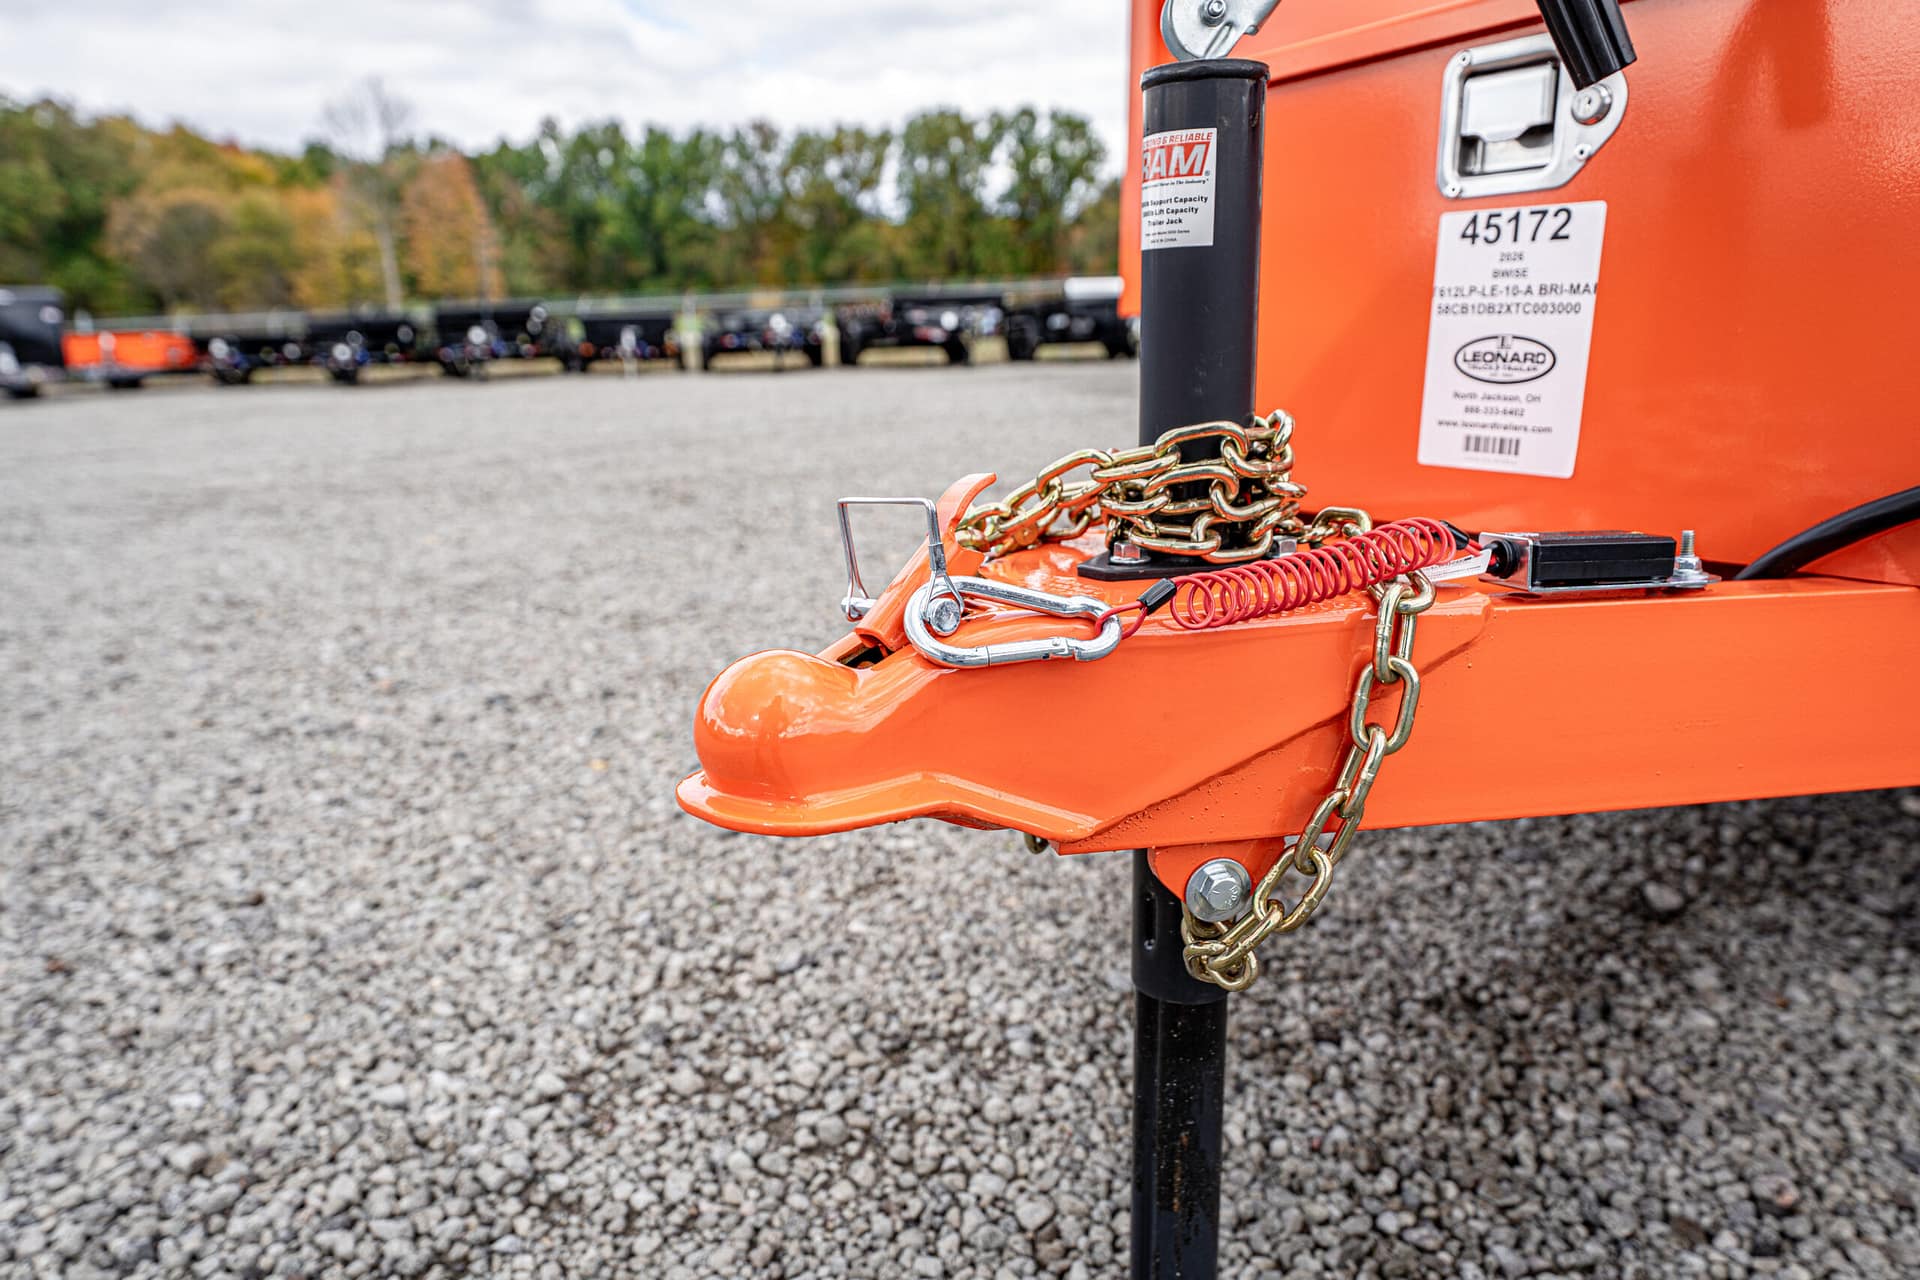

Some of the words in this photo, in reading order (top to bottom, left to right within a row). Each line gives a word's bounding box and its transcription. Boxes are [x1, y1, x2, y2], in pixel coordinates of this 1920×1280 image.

[1168, 132, 1213, 143] RELIABLE
[1150, 197, 1172, 206] Support
[1173, 194, 1208, 204] Capacity
[1154, 208, 1165, 216] Lift
[1166, 206, 1199, 215] Capacity
[1166, 217, 1183, 225] Jack
[1460, 207, 1573, 245] 45172
[1499, 251, 1524, 262] 2026
[1492, 267, 1528, 278] BWISE
[1462, 351, 1546, 364] LEONARD
[1453, 391, 1478, 400] North
[1526, 393, 1541, 403] OH
[1438, 419, 1552, 433] www.leonardtrailers.com
